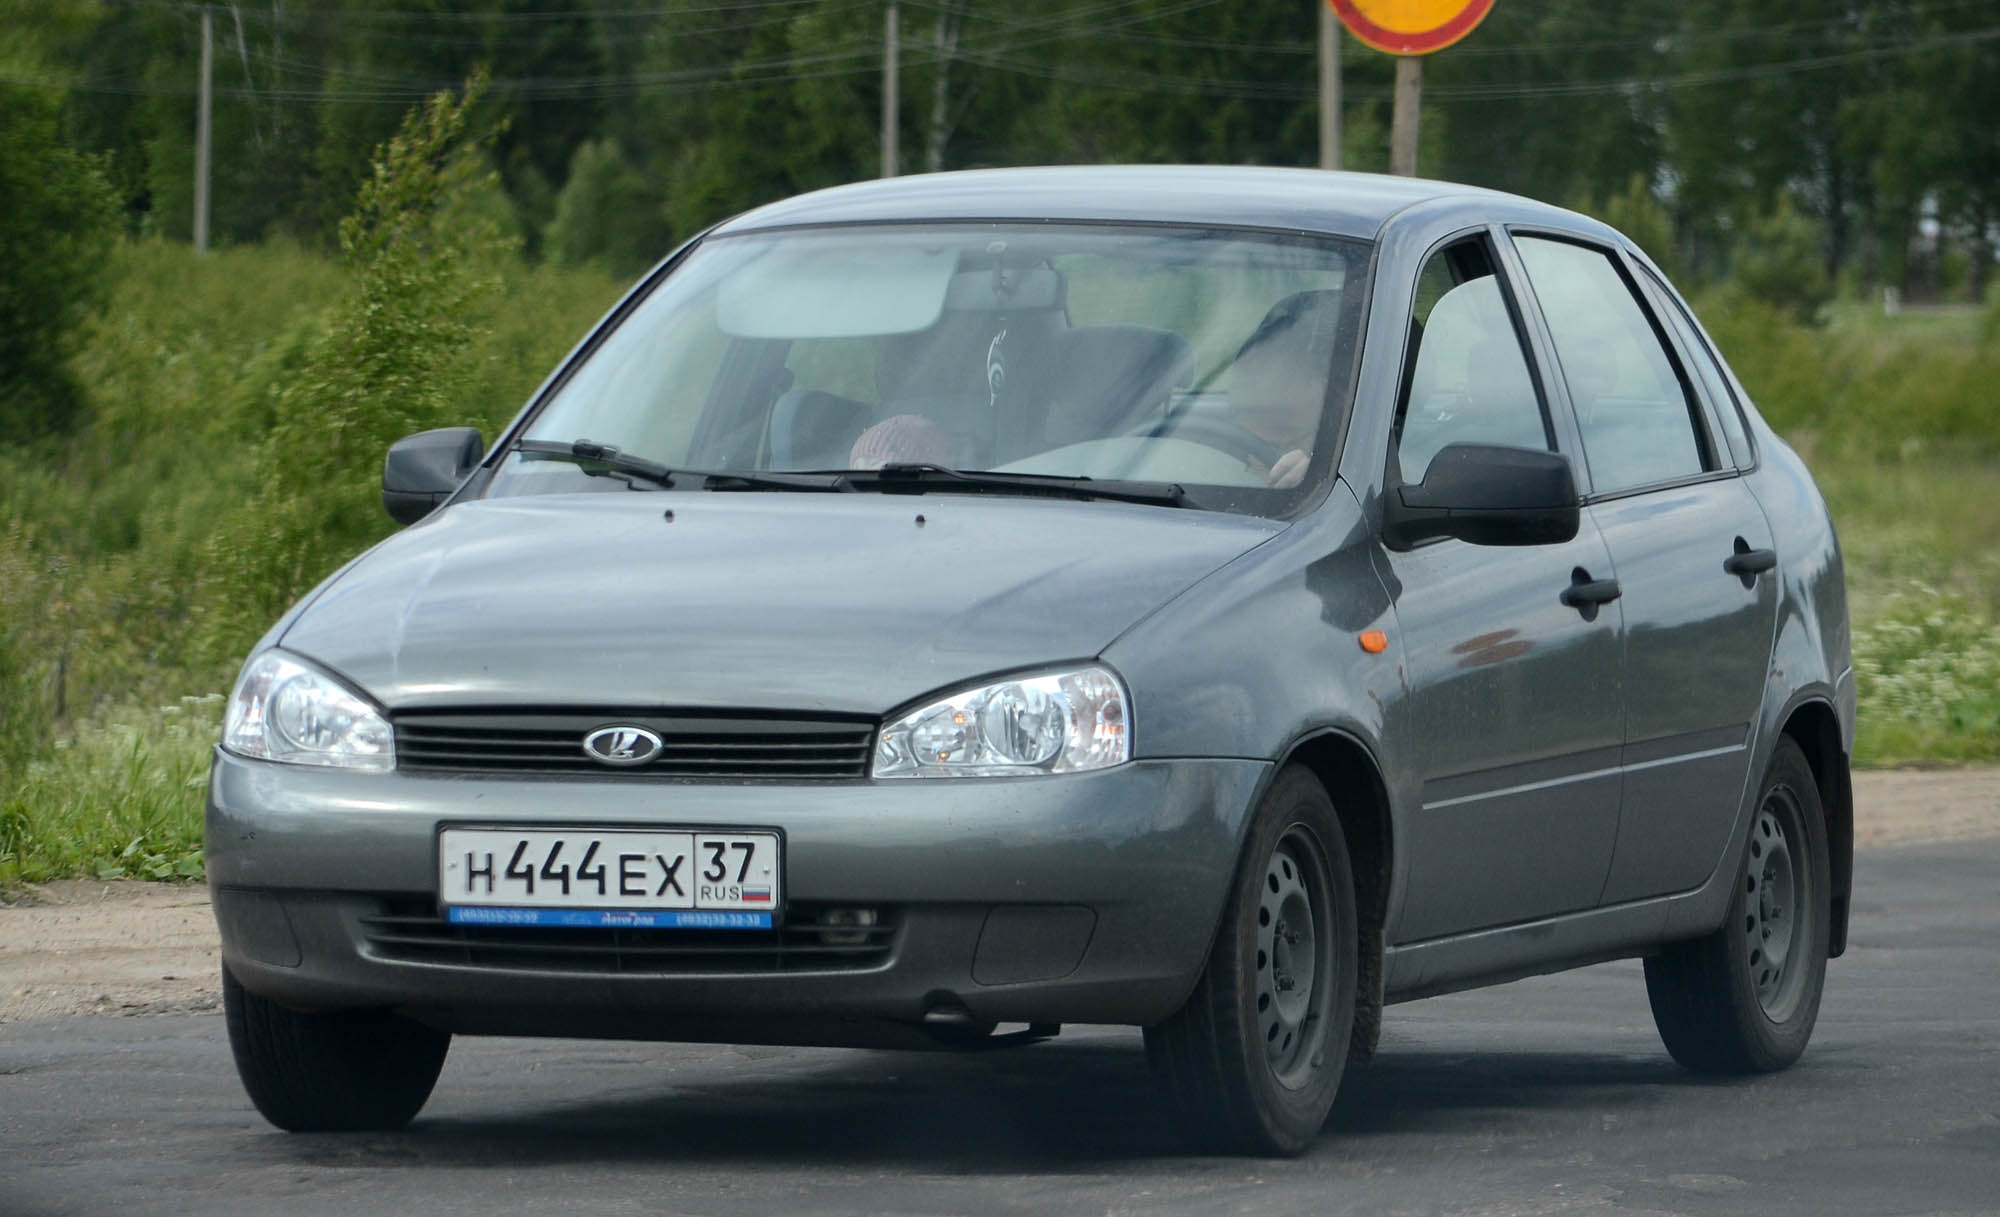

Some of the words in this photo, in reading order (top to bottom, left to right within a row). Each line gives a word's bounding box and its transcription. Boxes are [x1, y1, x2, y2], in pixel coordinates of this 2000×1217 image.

[466, 840, 686, 897] Н444ЕХ
[702, 840, 756, 883] 37
[700, 886, 741, 901] RUS
